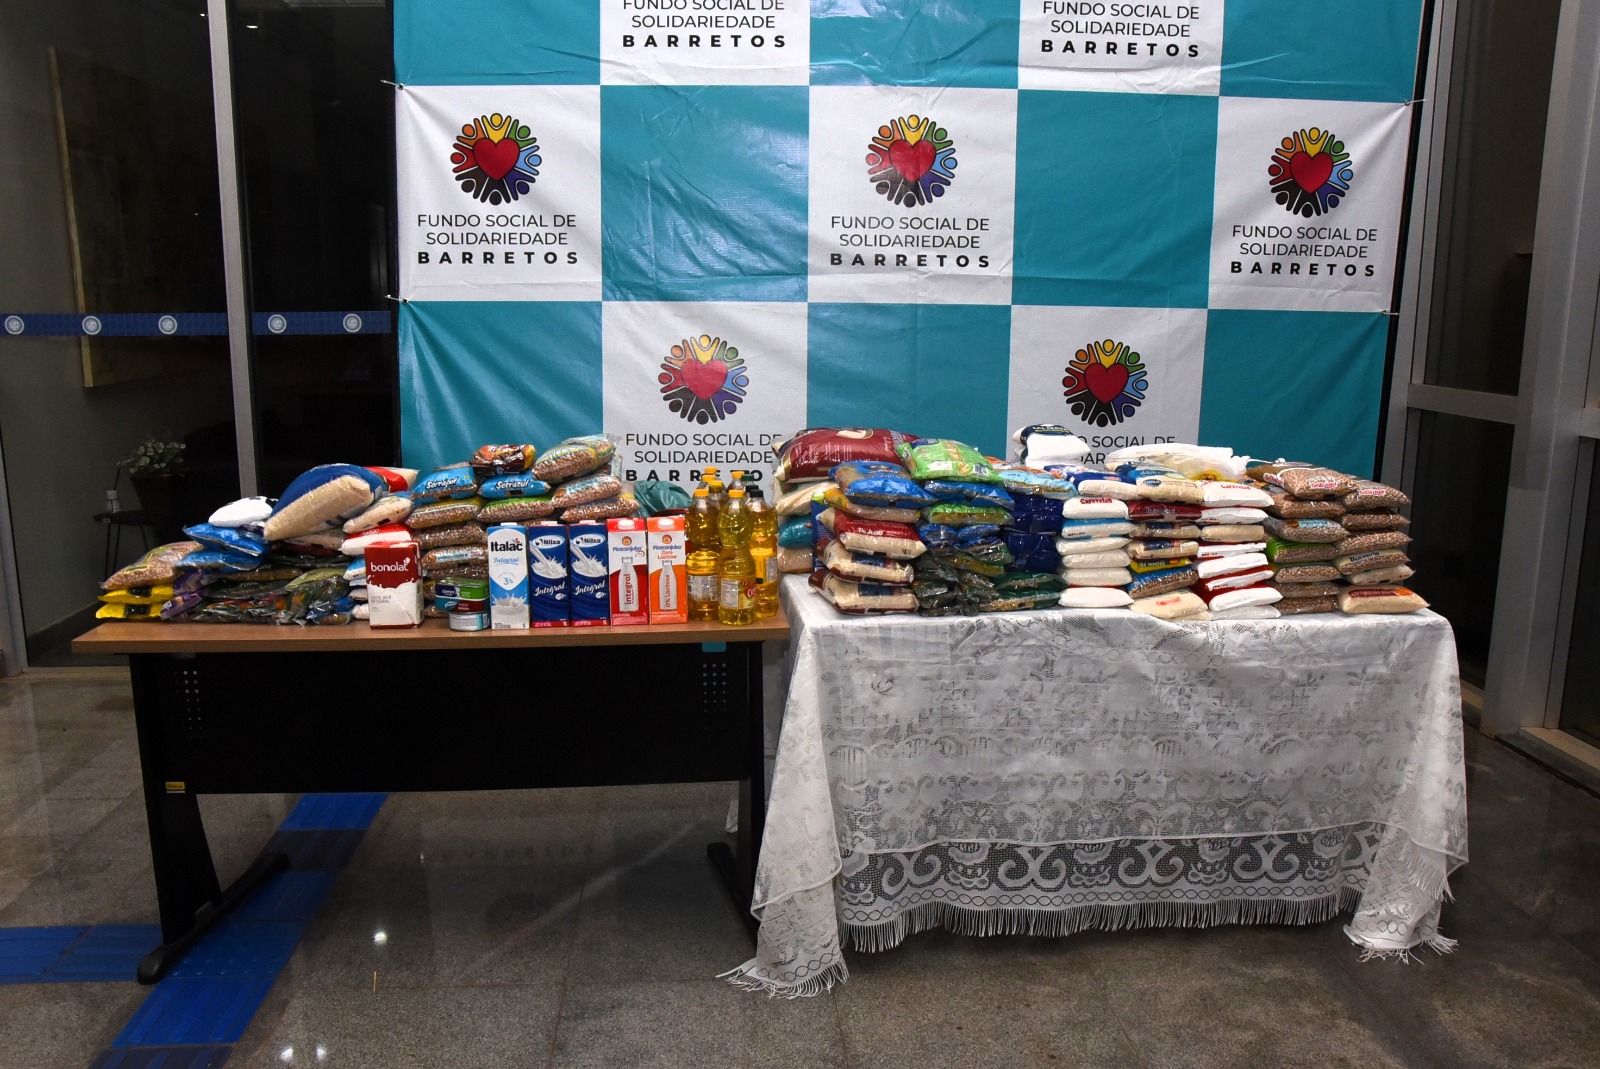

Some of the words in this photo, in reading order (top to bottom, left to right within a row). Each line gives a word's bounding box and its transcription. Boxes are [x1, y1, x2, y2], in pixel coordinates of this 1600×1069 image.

[623, 0, 688, 10] FUNDO
[692, 0, 756, 10] SOCIAL
[761, 0, 784, 10] DE
[1043, 1, 1106, 16] FUNDO
[1110, 4, 1172, 18] SOCIAL
[1177, 6, 1200, 19] DE
[631, 15, 776, 28] SOLIDARIEDADE
[1050, 20, 1190, 37] SOLIDARIEDADE
[622, 34, 786, 48] BARRETOS
[1041, 40, 1199, 58] BARRETOS
[418, 214, 480, 228] FUNDO
[485, 214, 548, 228] SOCIAL
[554, 214, 576, 228] DE
[832, 216, 894, 229] FUNDO
[899, 217, 961, 231] SOCIAL
[967, 218, 990, 231] DE
[426, 232, 568, 245] SOLIDARIEDADE
[1232, 225, 1292, 238] FUNDO
[1297, 227, 1352, 240] SOCIAL
[1356, 228, 1378, 242] DE
[839, 234, 980, 249] SOLIDARIEDADE
[418, 252, 578, 264] BARRETOS
[1240, 243, 1368, 258] SOLIDARIEDADE
[830, 253, 989, 268] BARRETOS
[1230, 261, 1374, 277] BARRETOS
[626, 433, 688, 446] FUNDO
[692, 433, 754, 446] SOCIAL
[634, 451, 773, 464] SOLIDARIEDADE
[490, 541, 523, 551] Italac
[534, 581, 565, 596] Integral
[575, 580, 605, 595] Integral
